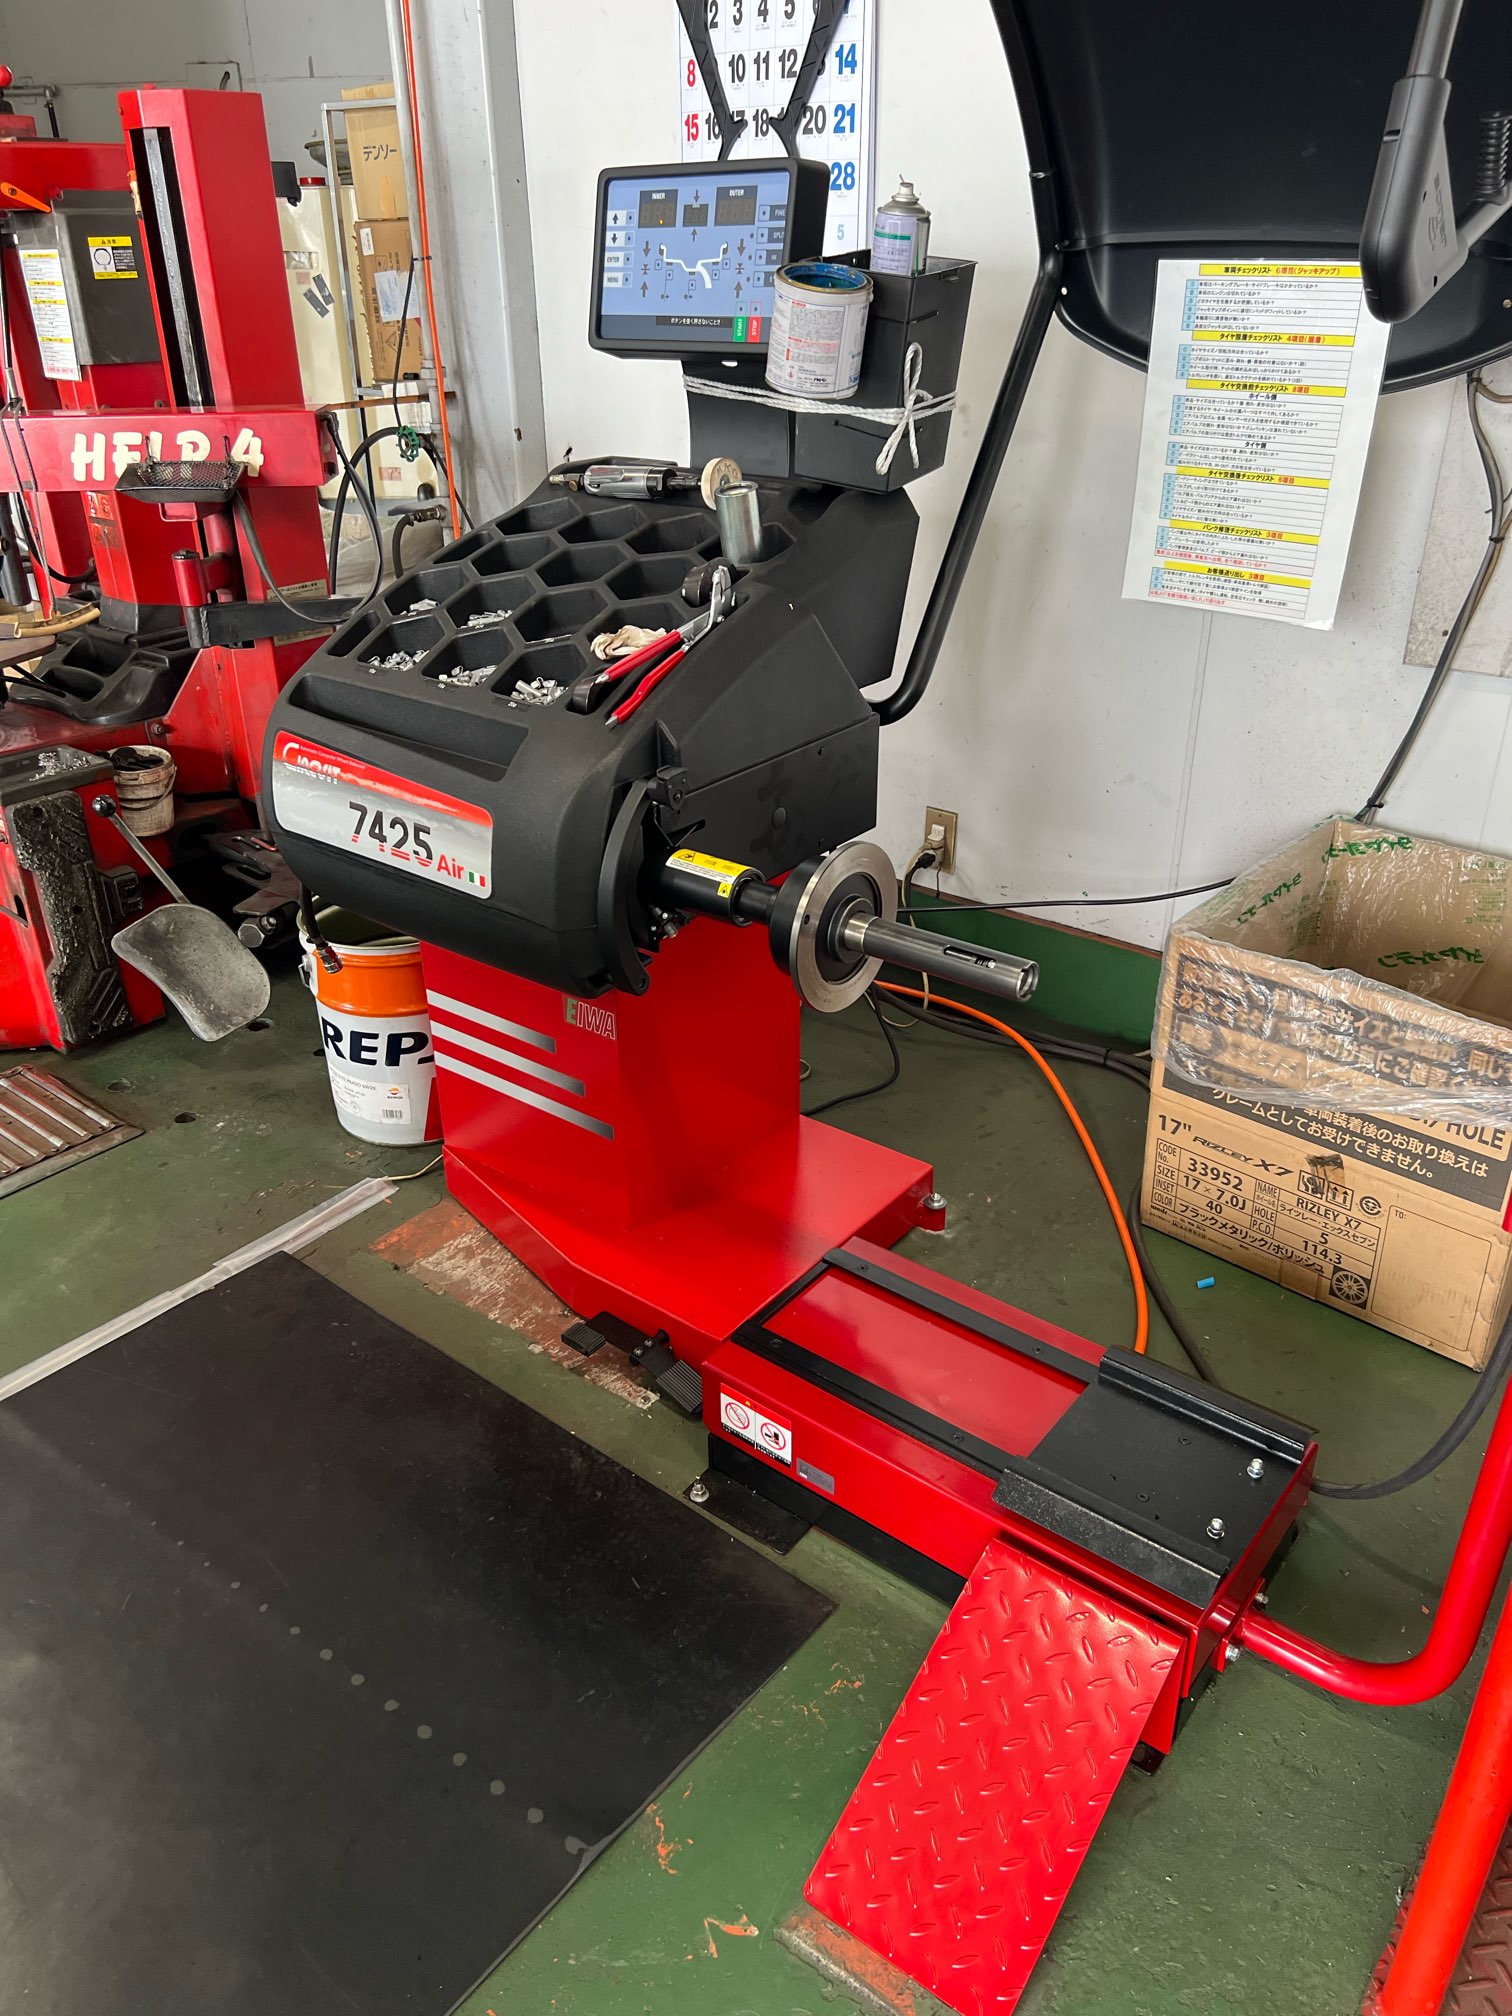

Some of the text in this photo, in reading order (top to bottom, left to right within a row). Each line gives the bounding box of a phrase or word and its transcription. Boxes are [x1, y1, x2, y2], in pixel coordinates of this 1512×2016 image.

[709, 0, 719, 28] 2
[733, 0, 743, 26] 3
[687, 59, 696, 88] 8
[728, 53, 746, 84] 10
[753, 51, 770, 81] 11
[778, 48, 798, 79] 12
[835, 43, 857, 75] 14
[685, 113, 699, 142] 15
[705, 112, 722, 140] 16
[752, 108, 770, 138] 18
[802, 105, 827, 135] 20
[833, 103, 856, 134] 21
[363, 144, 397, 162] デンソー
[830, 161, 856, 191] 28
[651, 192, 666, 200] INNER
[729, 189, 745, 197] OUTER
[837, 223, 845, 241] 5
[230, 427, 265, 478] 4
[349, 801, 466, 880] 7425 Air
[565, 999, 616, 1040] EIWA
[321, 1016, 434, 1067] REP
[1157, 1113, 1192, 1136] 17"
[1211, 1087, 1434, 1178] クレームとしてお受けできません。
[1158, 1141, 1177, 1157] CODE
[1158, 1151, 1169, 1163] No.
[1192, 1135, 1295, 1178] RIZLEY X7
[1157, 1165, 1176, 1181] SIZE
[1187, 1157, 1244, 1192] 33952
[1155, 1178, 1175, 1194] INSET
[1183, 1174, 1200, 1192] 17
[1216, 1188, 1248, 1211] 7.0J
[1256, 1181, 1278, 1199] NAME
[1153, 1192, 1174, 1208] COLOR
[1206, 1200, 1223, 1215] 40
[1253, 1205, 1276, 1223] HOLE
[1295, 1195, 1362, 1230] RIZLEY X7
[1394, 1209, 1408, 1220] TO:
[1179, 1202, 1326, 1275] ブラックメタリック/ポリッシュ
[1252, 1218, 1273, 1236] P.C.D.
[1318, 1233, 1329, 1244] 5
[1302, 1240, 1342, 1266] 114.3
